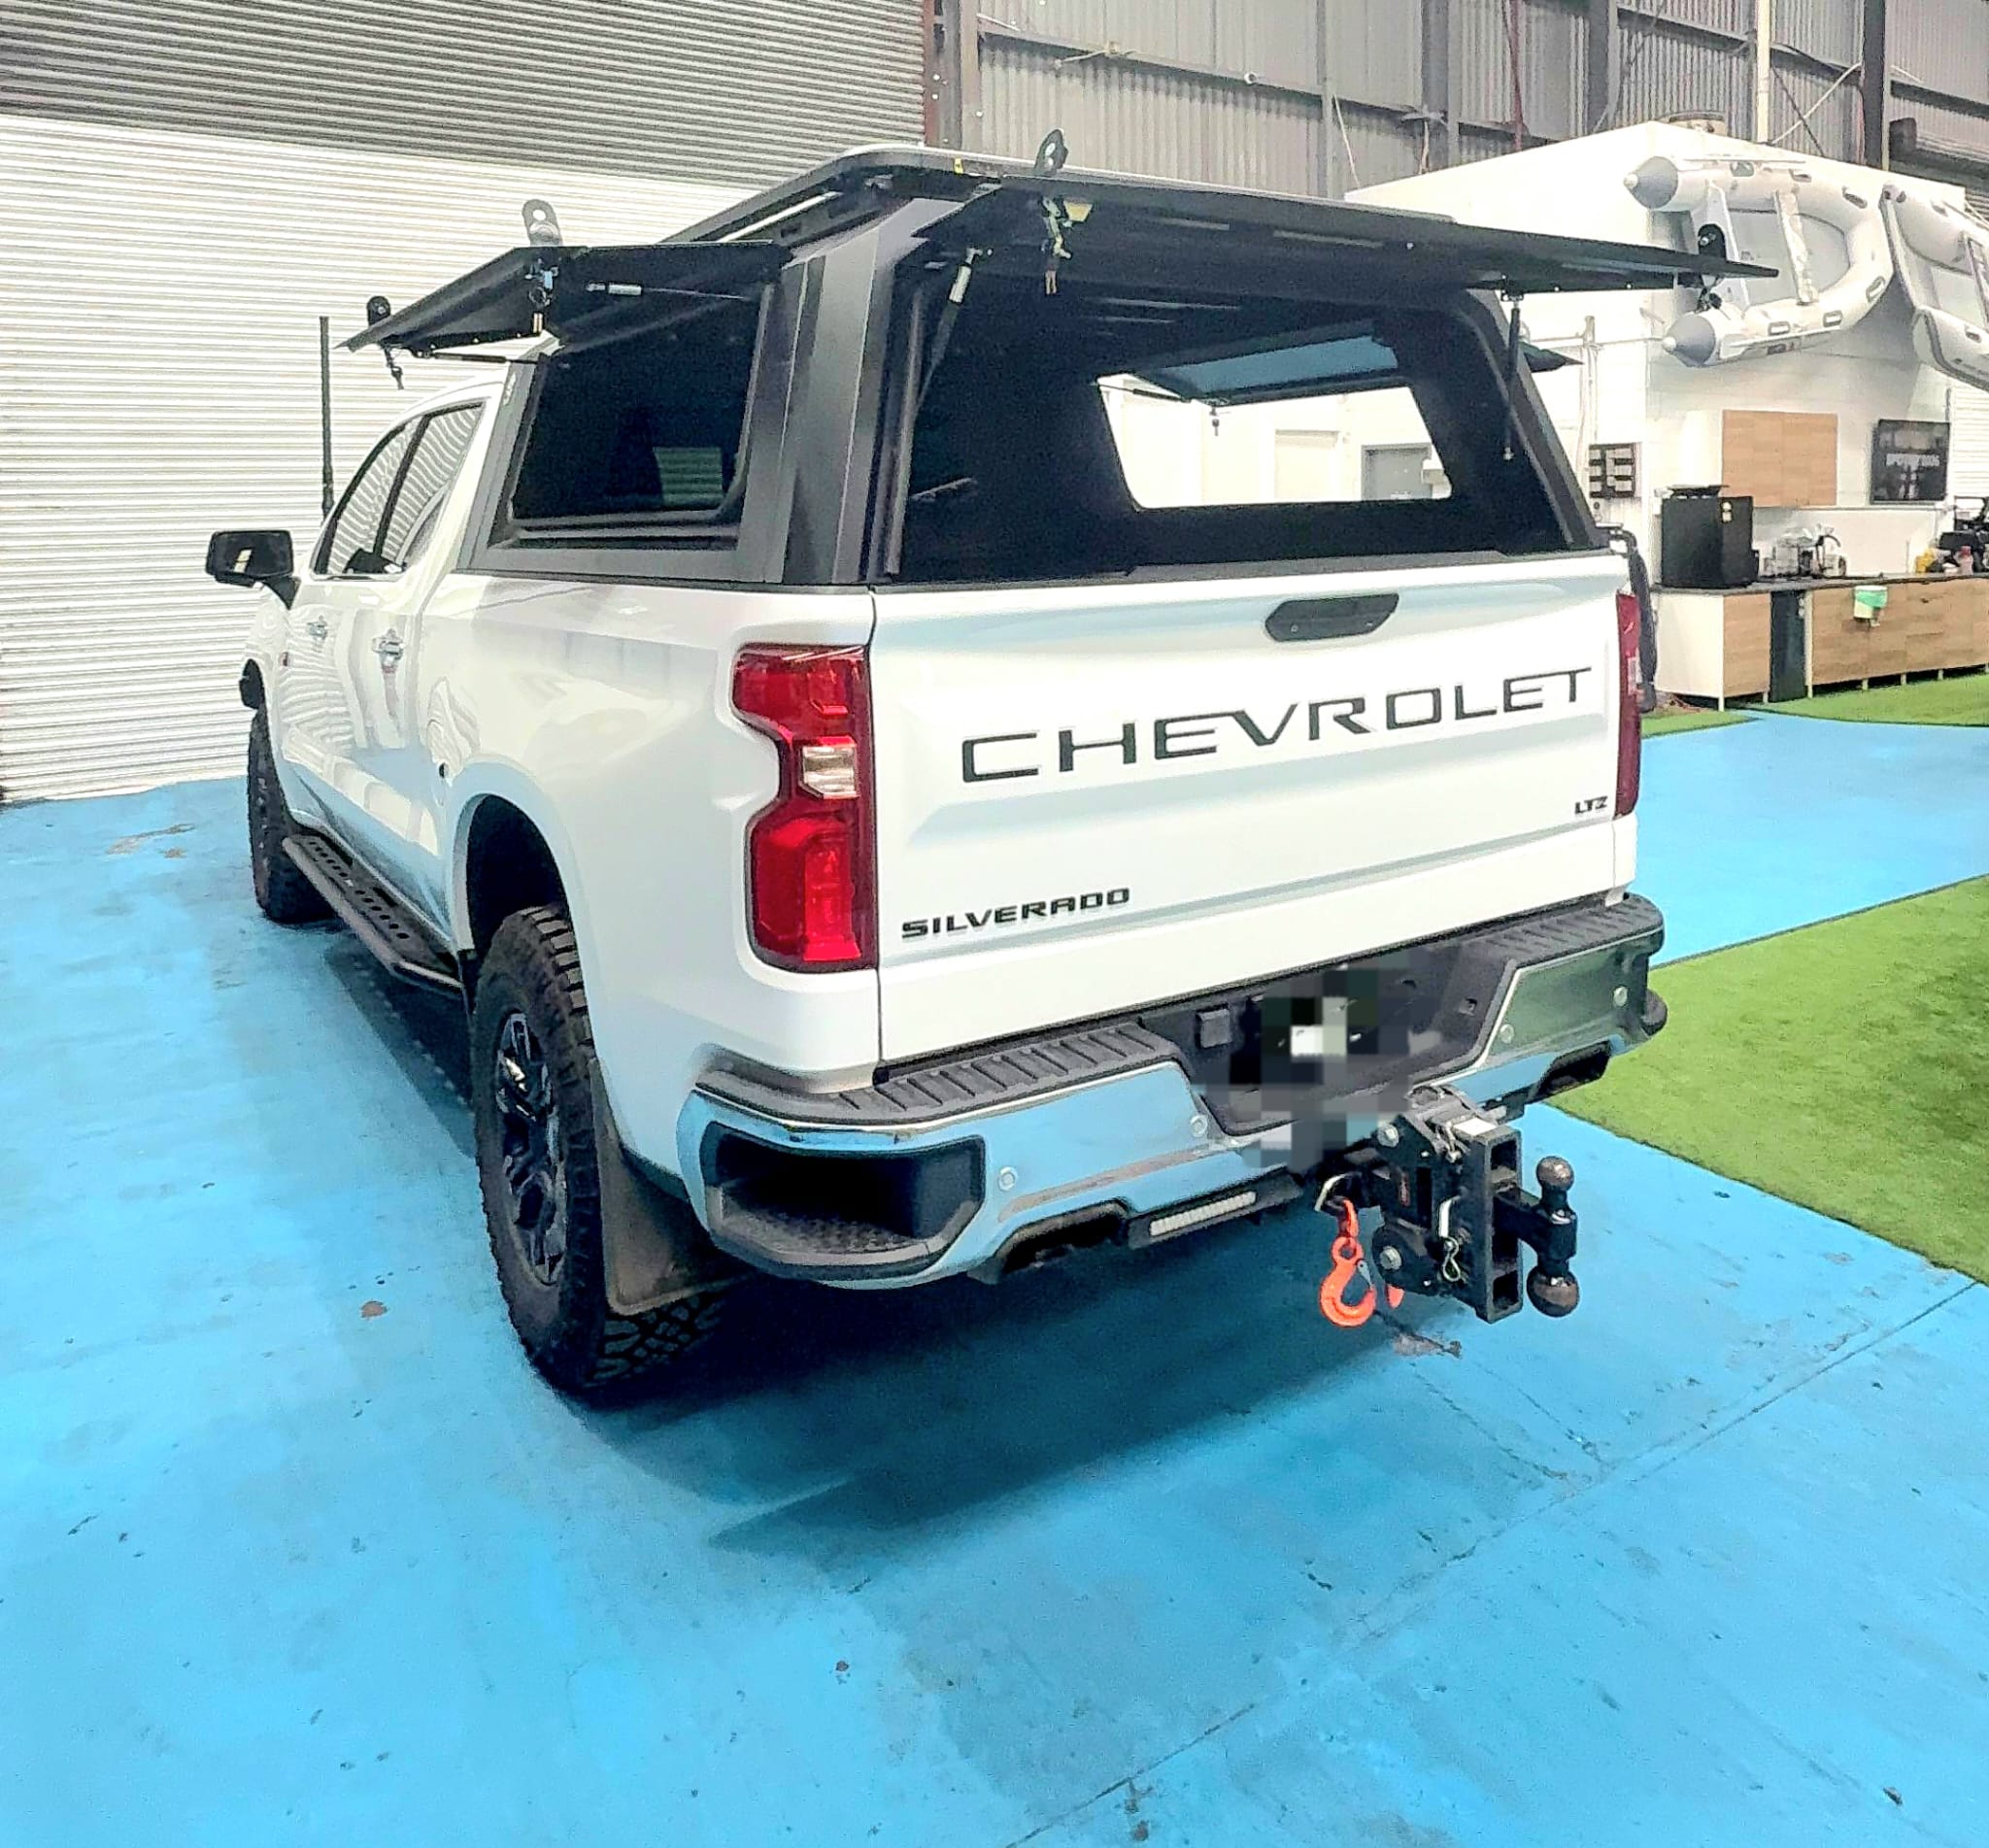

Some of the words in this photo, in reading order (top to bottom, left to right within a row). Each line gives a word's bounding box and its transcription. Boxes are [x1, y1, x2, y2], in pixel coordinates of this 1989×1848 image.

[961, 667, 1592, 783] CHEVROLET
[1574, 795, 1608, 815] LTZ
[901, 888, 1130, 939] SILVERADO
